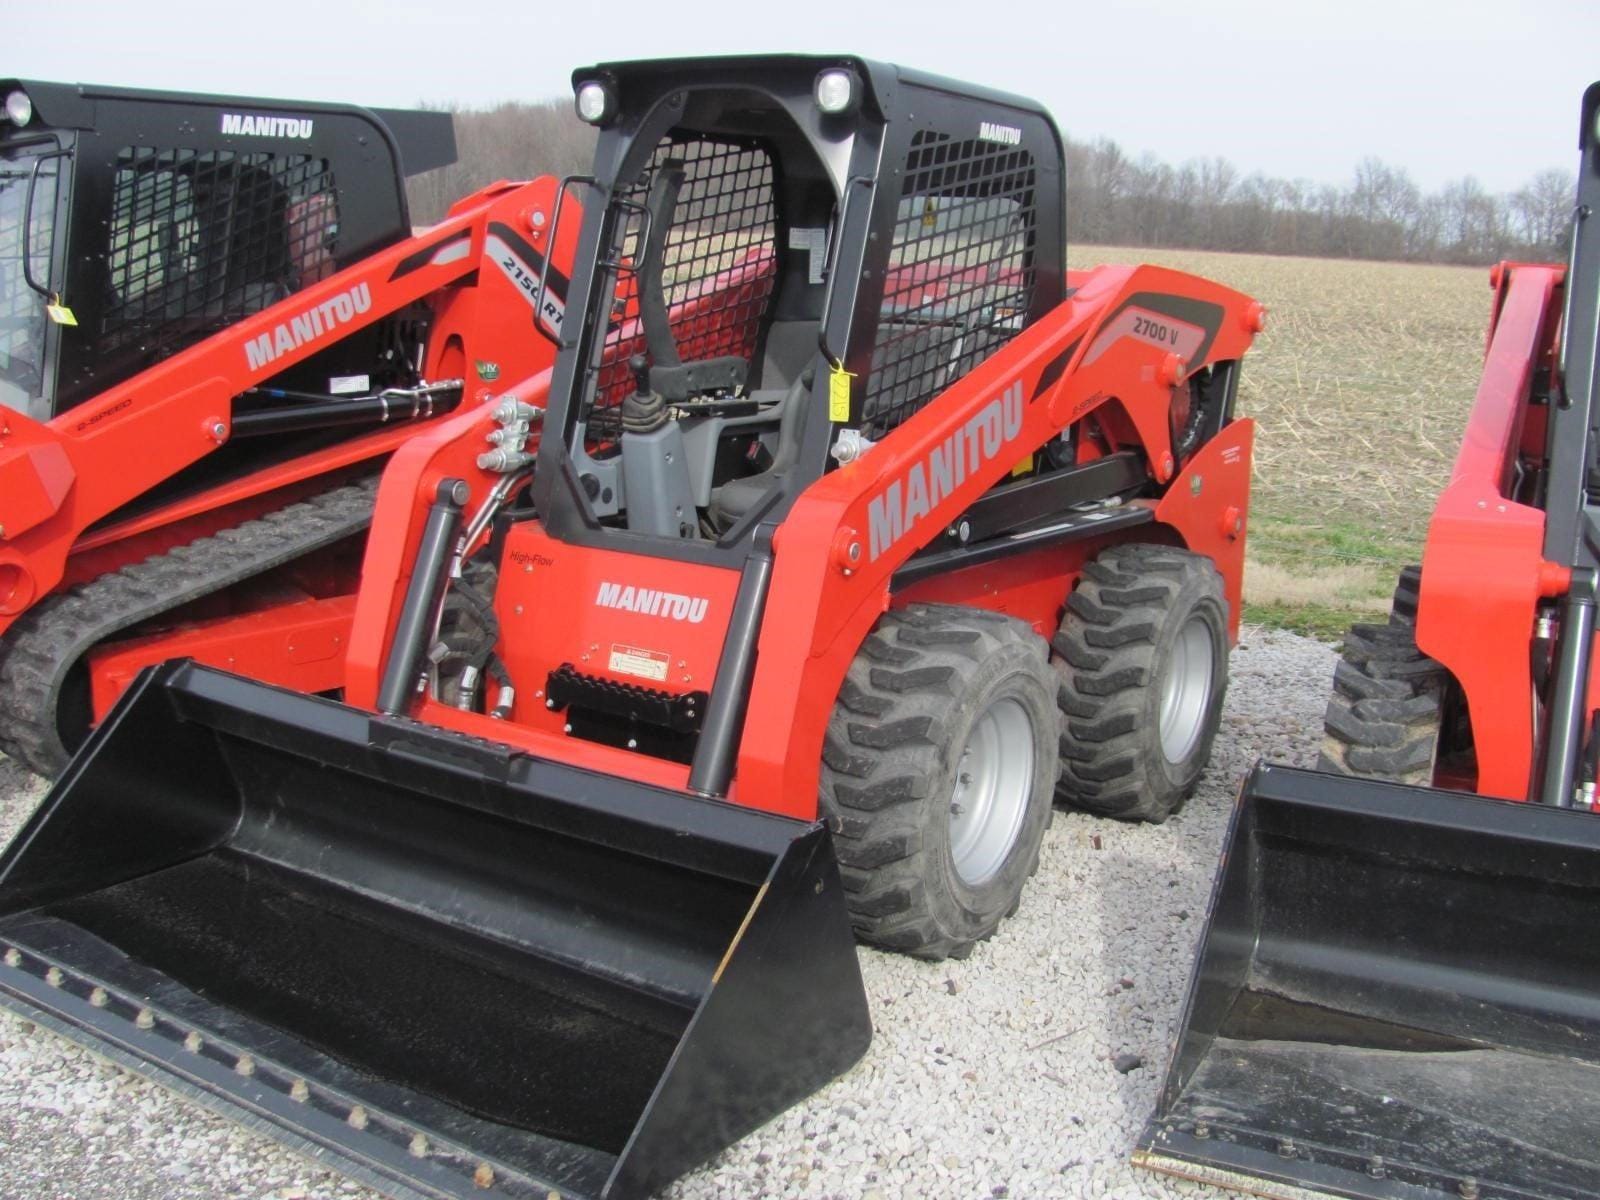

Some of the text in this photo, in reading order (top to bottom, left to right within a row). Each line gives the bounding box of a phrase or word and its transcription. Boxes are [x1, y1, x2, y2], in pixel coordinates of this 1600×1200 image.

[222, 114, 313, 139] MANITOU
[980, 121, 1021, 145] MANITOU
[244, 281, 371, 372] MANITOU
[544, 302, 564, 324] RT
[1133, 316, 1179, 345] 2700 V
[868, 379, 1023, 562] MANITOU
[510, 550, 555, 567] High-Flow
[595, 582, 709, 623] MANITOU
